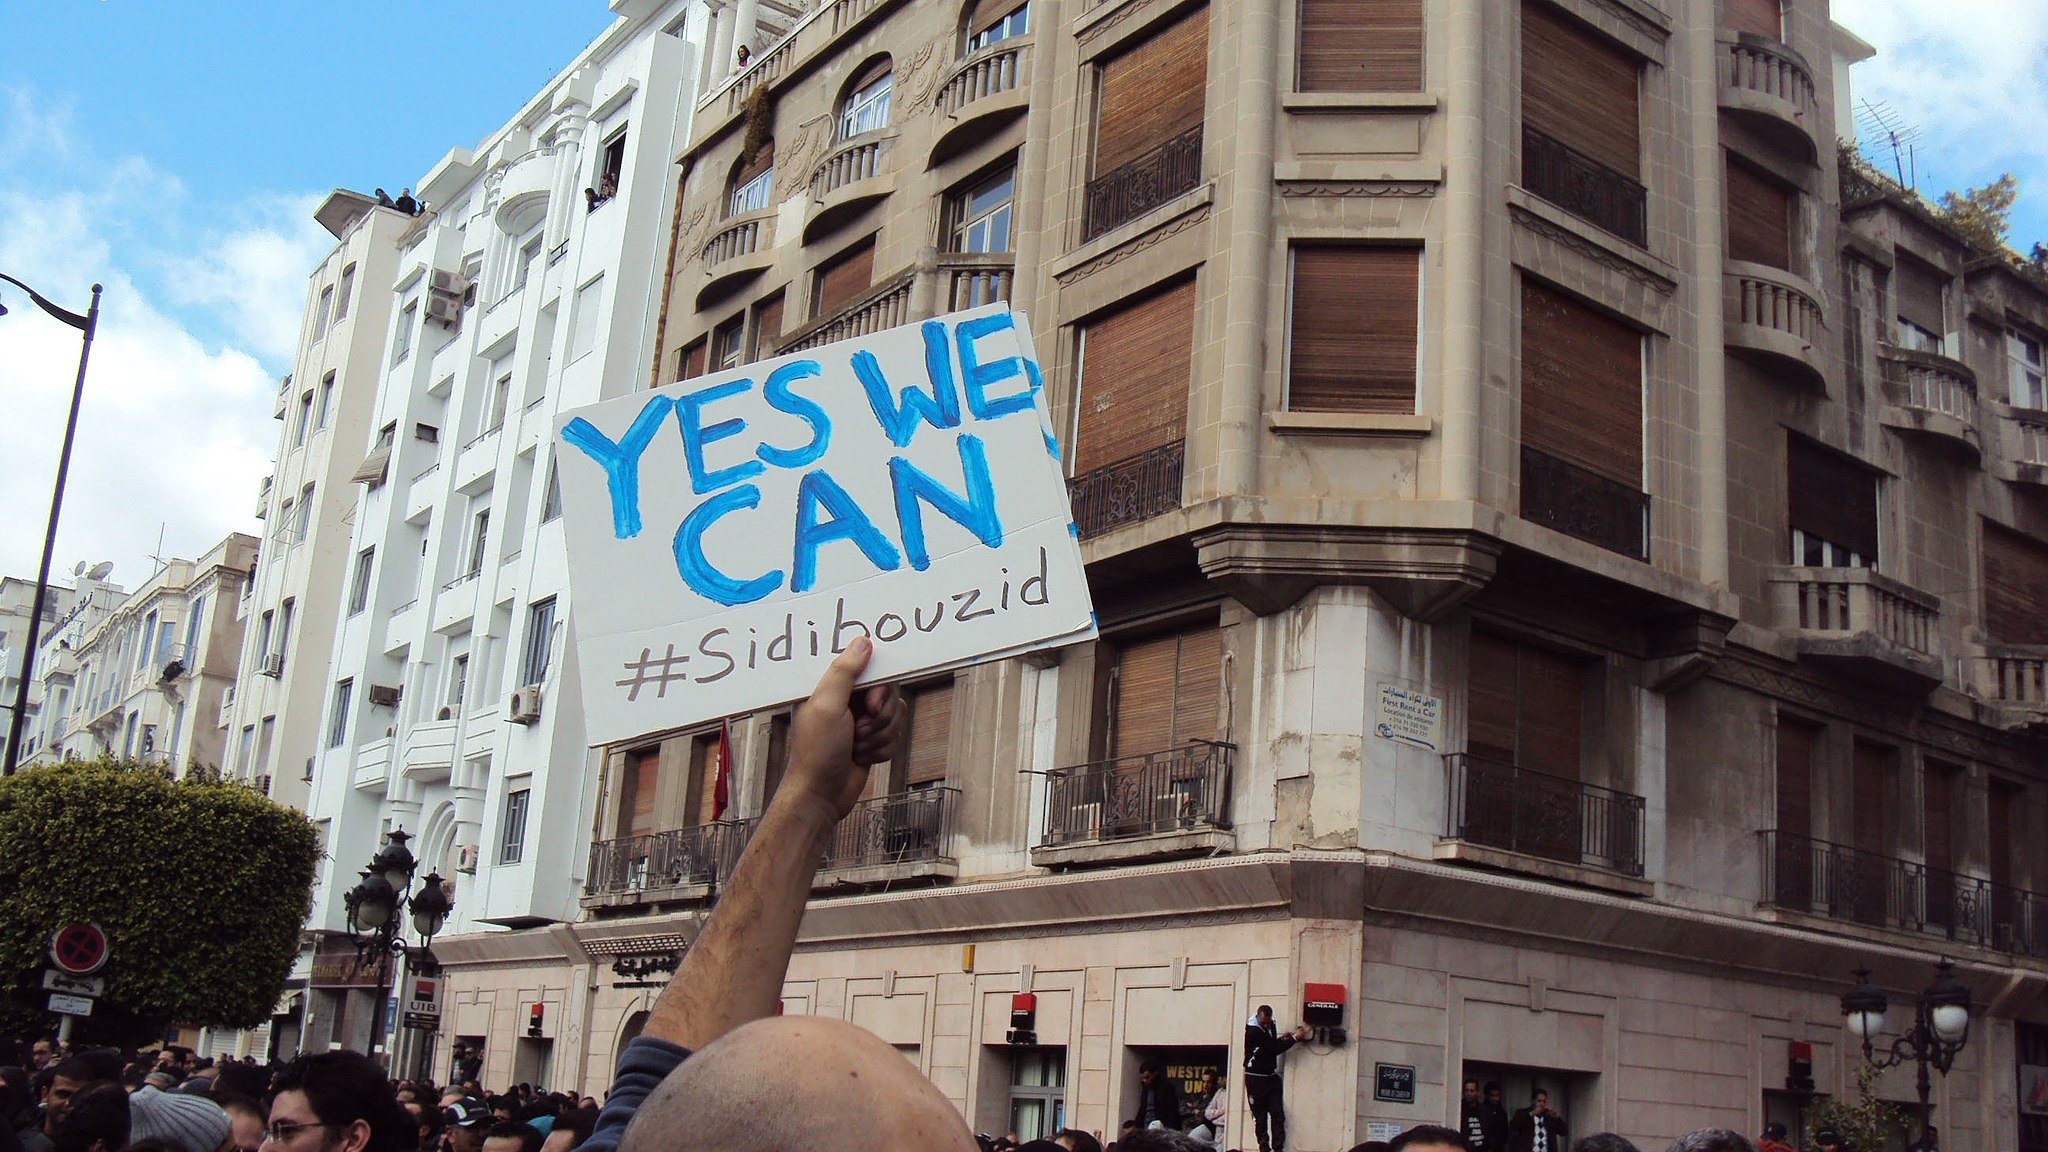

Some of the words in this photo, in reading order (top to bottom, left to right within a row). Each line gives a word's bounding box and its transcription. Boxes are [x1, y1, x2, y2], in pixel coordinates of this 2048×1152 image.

[562, 360, 832, 540] YES
[851, 311, 1040, 448] WE
[673, 433, 1005, 606] CAN
[615, 546, 1050, 702] #Sidibouzid
[1383, 697, 1398, 708] First
[1400, 702, 1416, 713] Rent
[1423, 708, 1436, 718] Car
[410, 1001, 437, 1012] UIB
